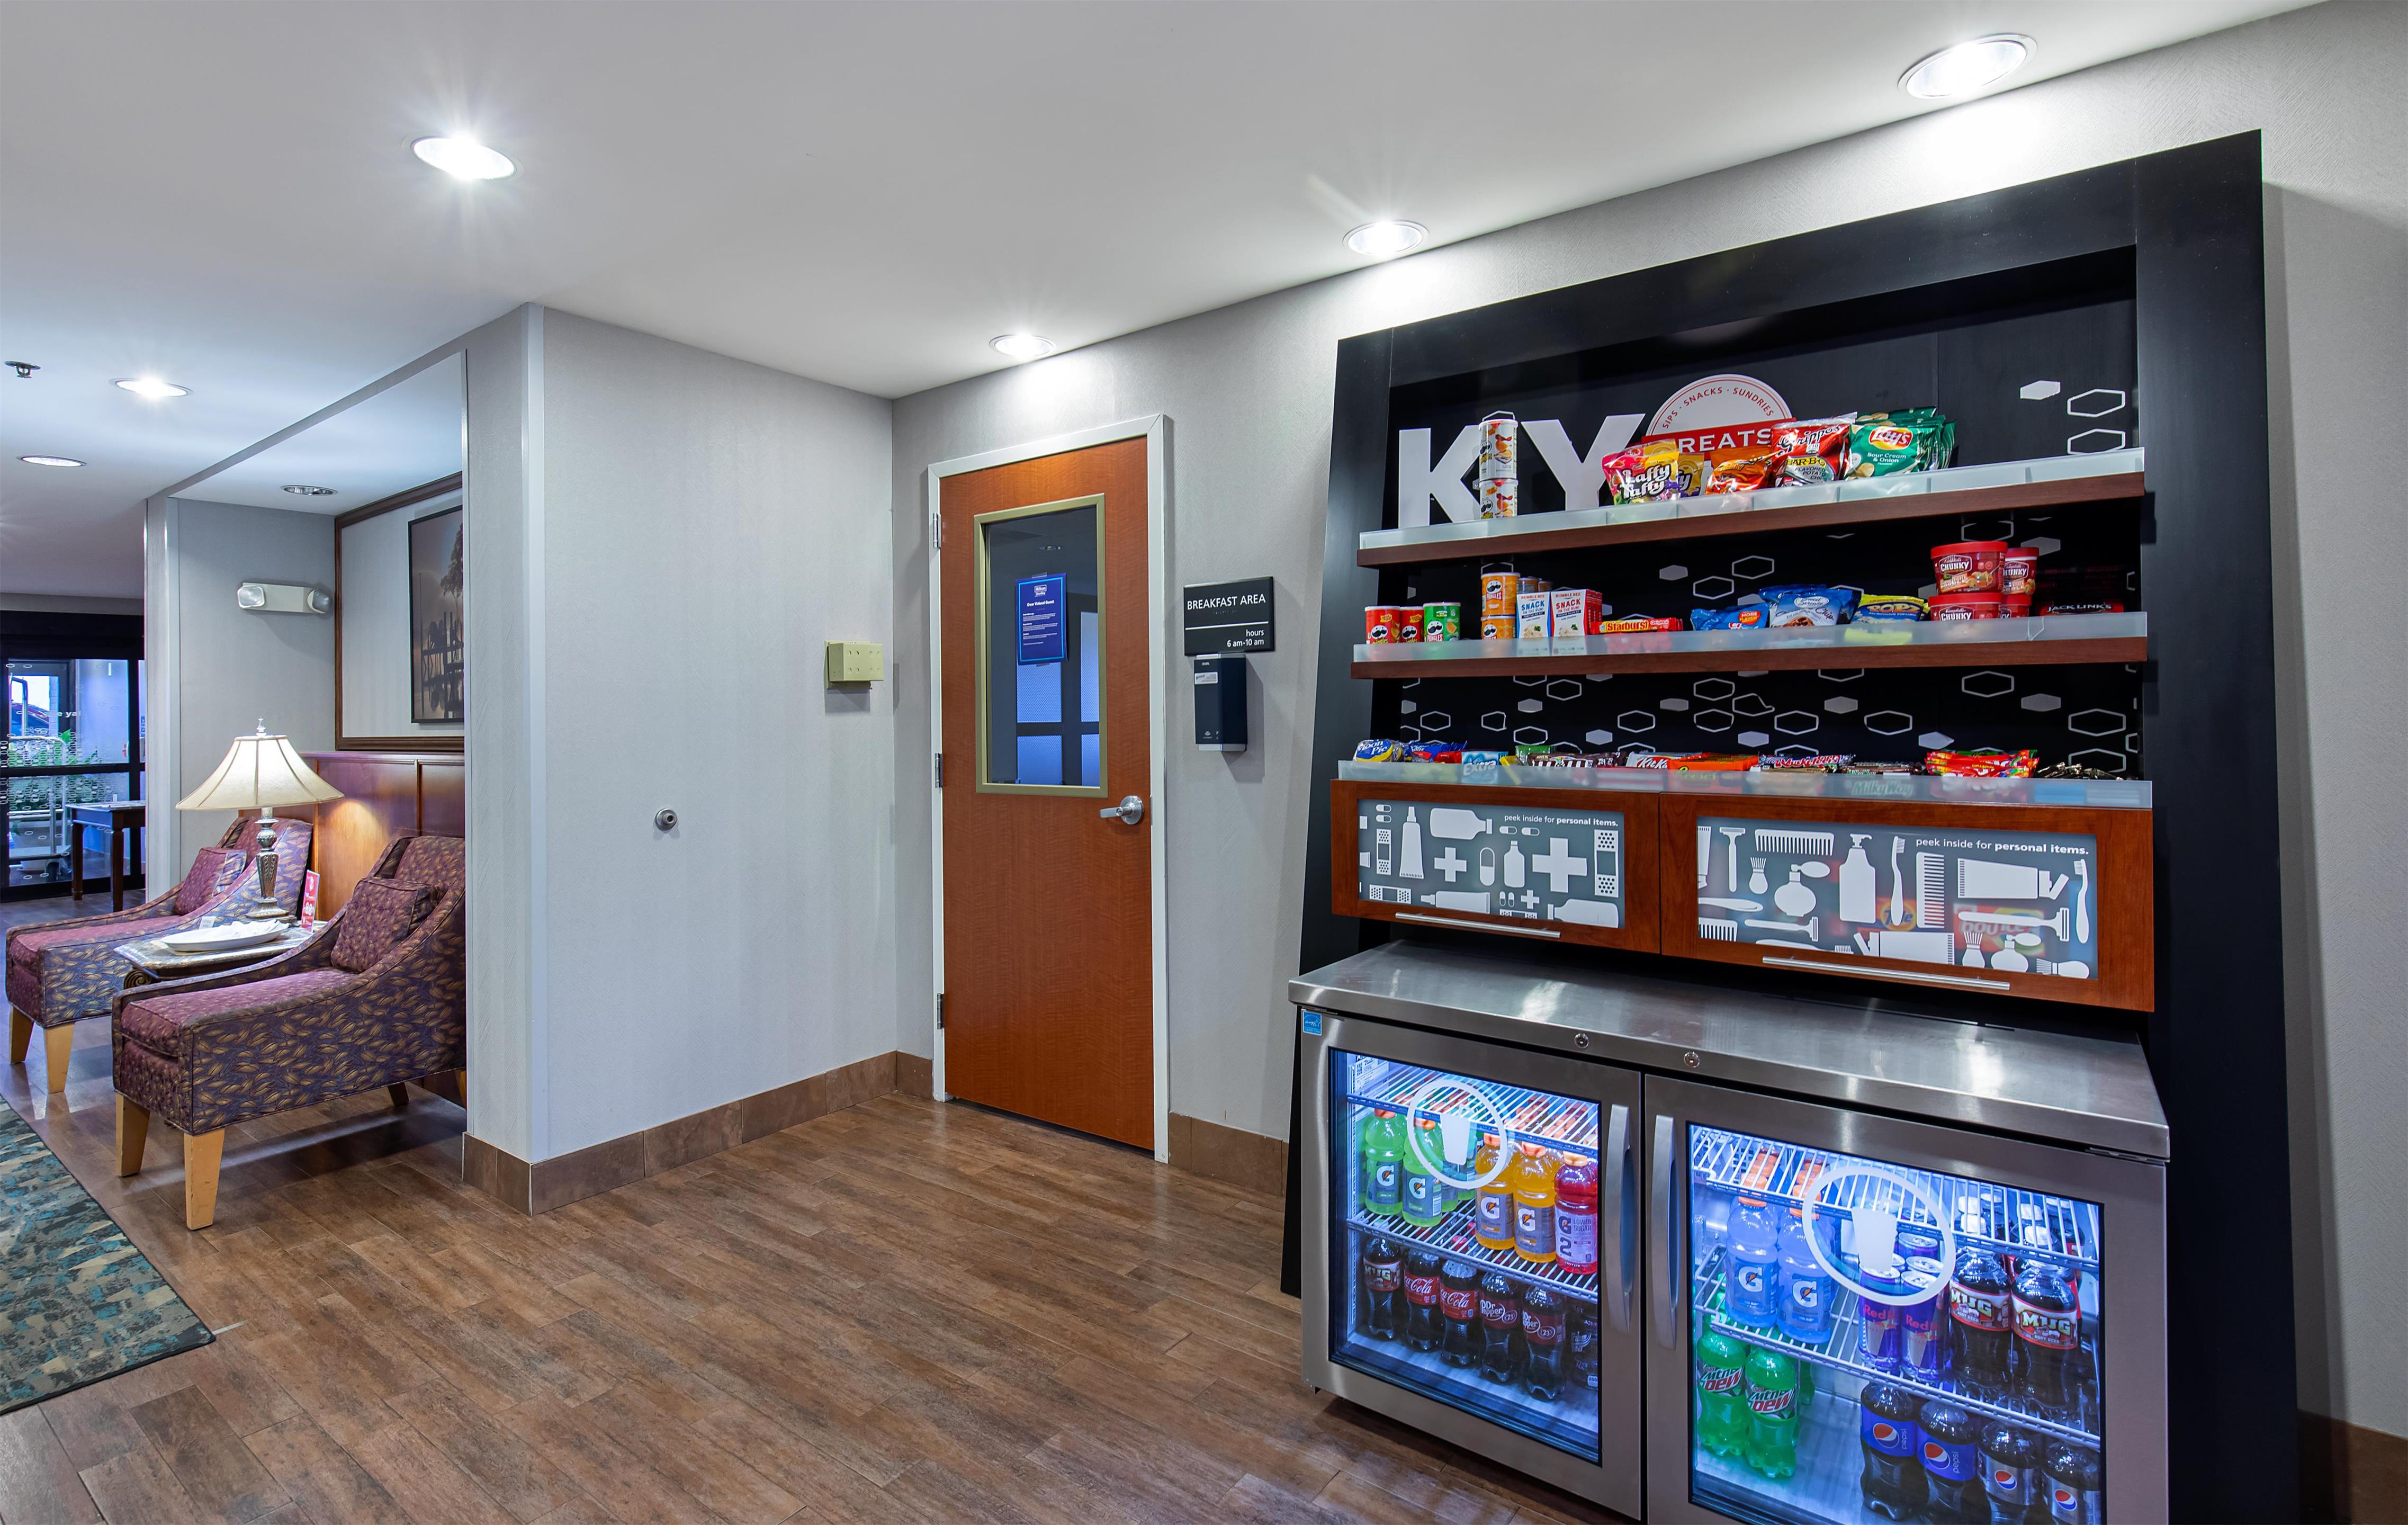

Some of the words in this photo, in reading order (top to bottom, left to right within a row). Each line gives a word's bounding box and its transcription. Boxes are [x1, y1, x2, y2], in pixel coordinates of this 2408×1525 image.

[1663, 410, 1678, 428] SIPS
[1684, 387, 1722, 407] SNACKS
[1733, 387, 1773, 417] SUNDRIES
[1646, 428, 1772, 453] REATS
[1872, 428, 1910, 445] Lay's
[1623, 465, 1670, 483] Laffy
[1620, 480, 1664, 498] Taffy
[1940, 561, 1970, 572] CHUNKY
[1187, 596, 1237, 609] BREAKFAST
[1240, 594, 1266, 604] AREA
[1522, 600, 1544, 611] SNACK
[1556, 598, 1580, 609] SNACK
[1941, 613, 1972, 621] CHUNKY
[1463, 760, 1496, 776] Extra
[1916, 838, 1939, 847] peek
[1944, 839, 1973, 848] inside
[1976, 840, 1991, 849] for
[1995, 842, 2046, 853] personal
[2051, 844, 2089, 855] items.
[1377, 1165, 1395, 1187] G
[1409, 1177, 1426, 1199] G
[1481, 1197, 1499, 1219] G
[1517, 1208, 1535, 1232] G
[1738, 1266, 1762, 1292] G
[1793, 1280, 1817, 1307] G
[1951, 1288, 1992, 1317] MUG
[1486, 1301, 1496, 1309] Dr
[1864, 1304, 1886, 1320] Red
[1906, 1314, 1929, 1331] Red
[1968, 1314, 1979, 1323] BEER
[2023, 1311, 2071, 1335] MUG
[1952, 1451, 1960, 1474] pepsi
